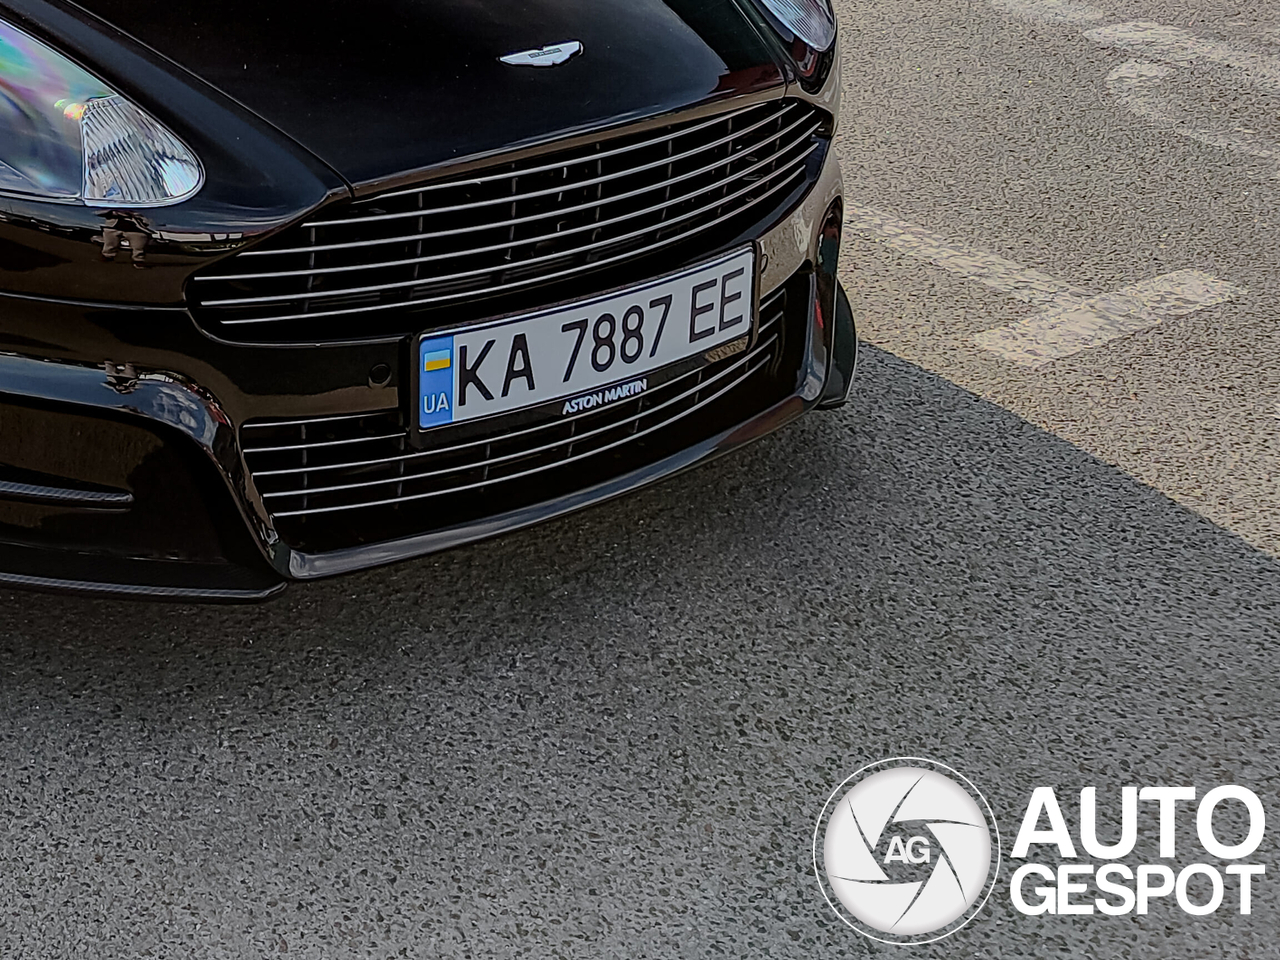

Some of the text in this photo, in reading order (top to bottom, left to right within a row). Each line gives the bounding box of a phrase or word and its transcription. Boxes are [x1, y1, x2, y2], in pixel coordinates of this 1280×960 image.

[458, 268, 745, 407] KA 7887 EE
[423, 392, 450, 414] UA
[561, 379, 648, 416] ASTON MARTIN
